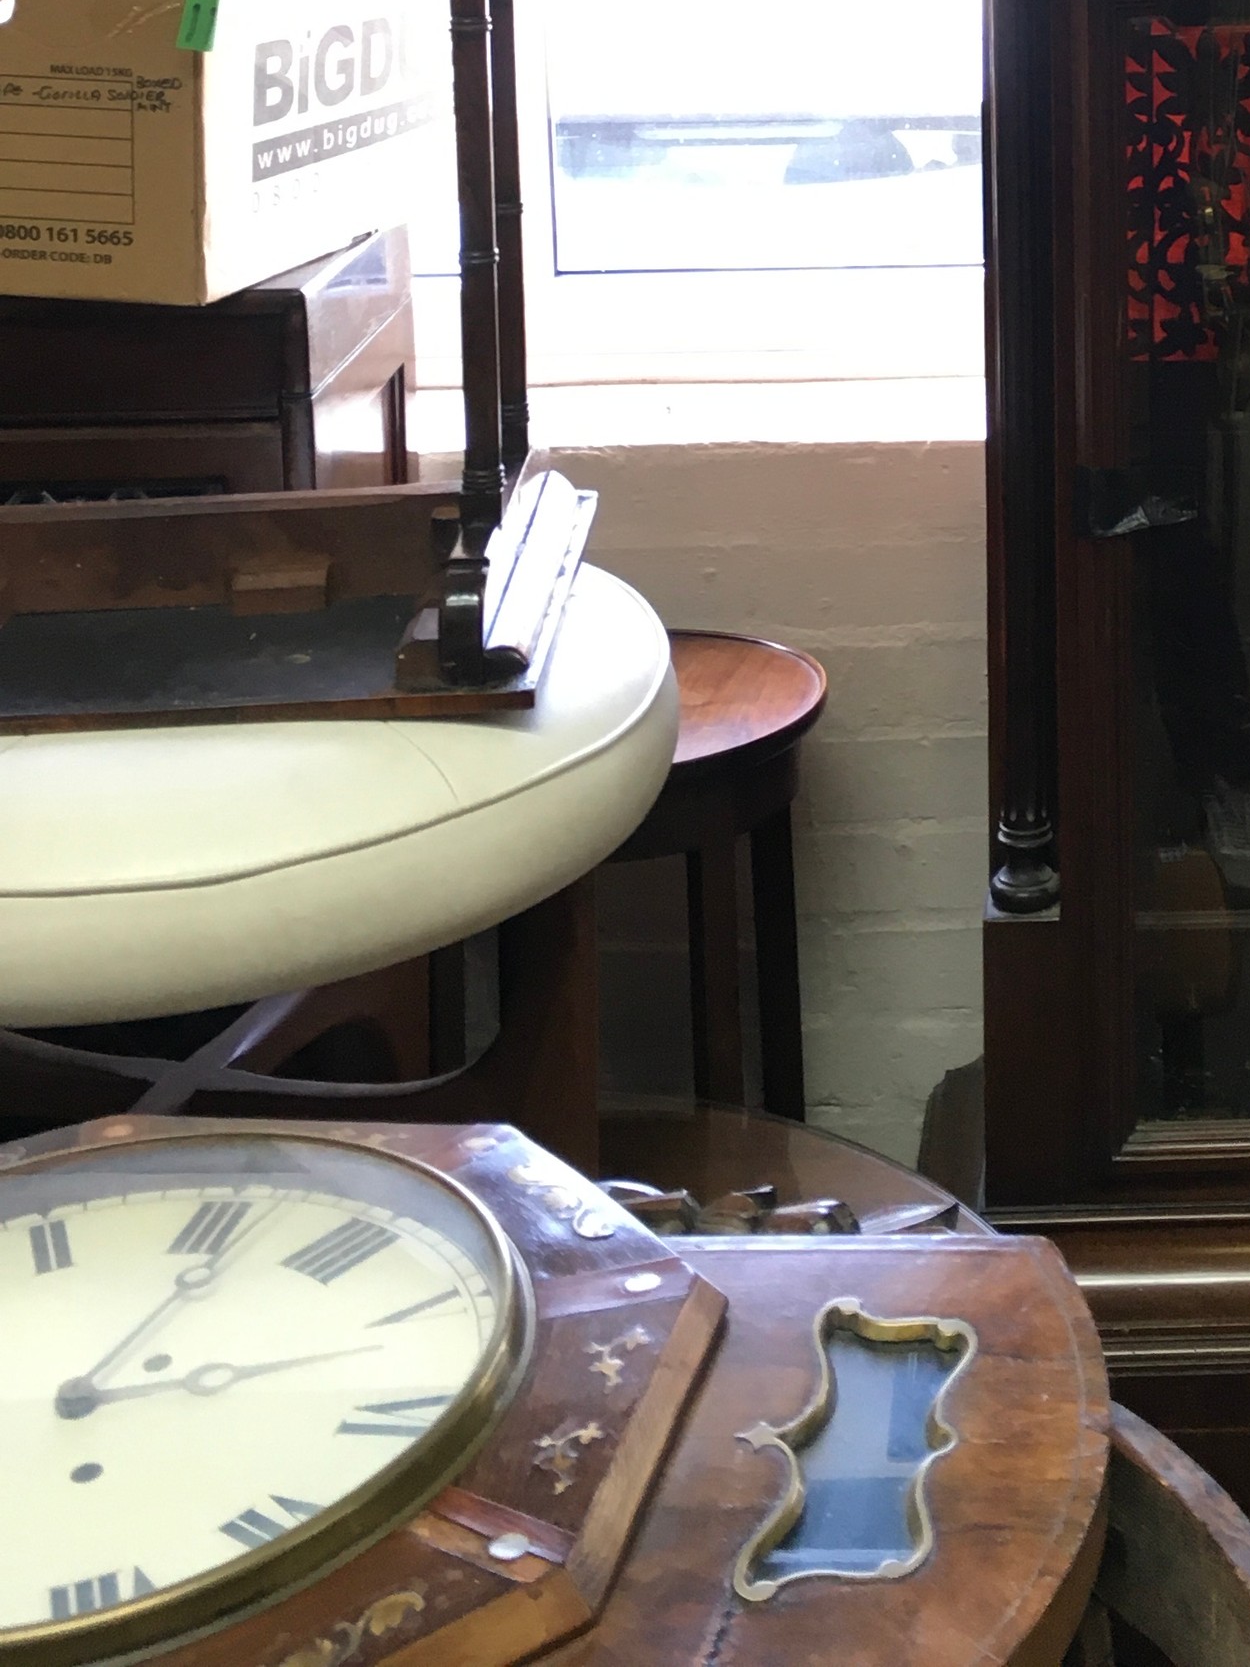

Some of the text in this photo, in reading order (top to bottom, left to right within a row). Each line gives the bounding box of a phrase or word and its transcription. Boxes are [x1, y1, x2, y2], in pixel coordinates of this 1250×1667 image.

[50, 64, 74, 75] MAX
[75, 65, 105, 77] LOAD
[46, 227, 78, 243] 161
[85, 229, 134, 246] 5665
[2, 248, 47, 261] ORDER
[93, 254, 112, 264] DB
[166, 1201, 254, 1255] III
[29, 1220, 74, 1275] II
[277, 1216, 403, 1286] IIII
